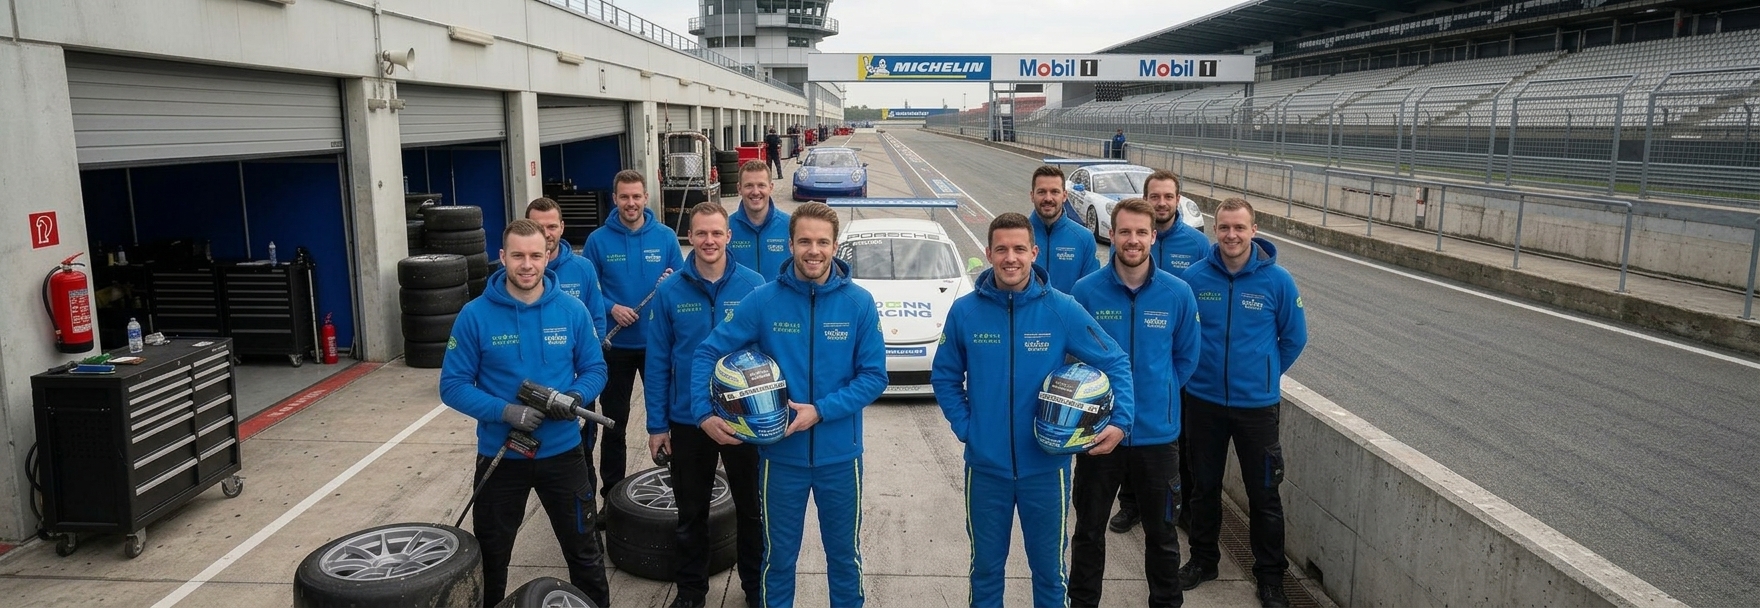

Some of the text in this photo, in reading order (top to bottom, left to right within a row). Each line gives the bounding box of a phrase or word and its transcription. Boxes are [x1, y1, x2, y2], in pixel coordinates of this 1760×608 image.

[893, 61, 985, 73] MICHELIN
[1019, 59, 1095, 76] Mobil 1
[1139, 59, 1213, 77] Mobil 1
